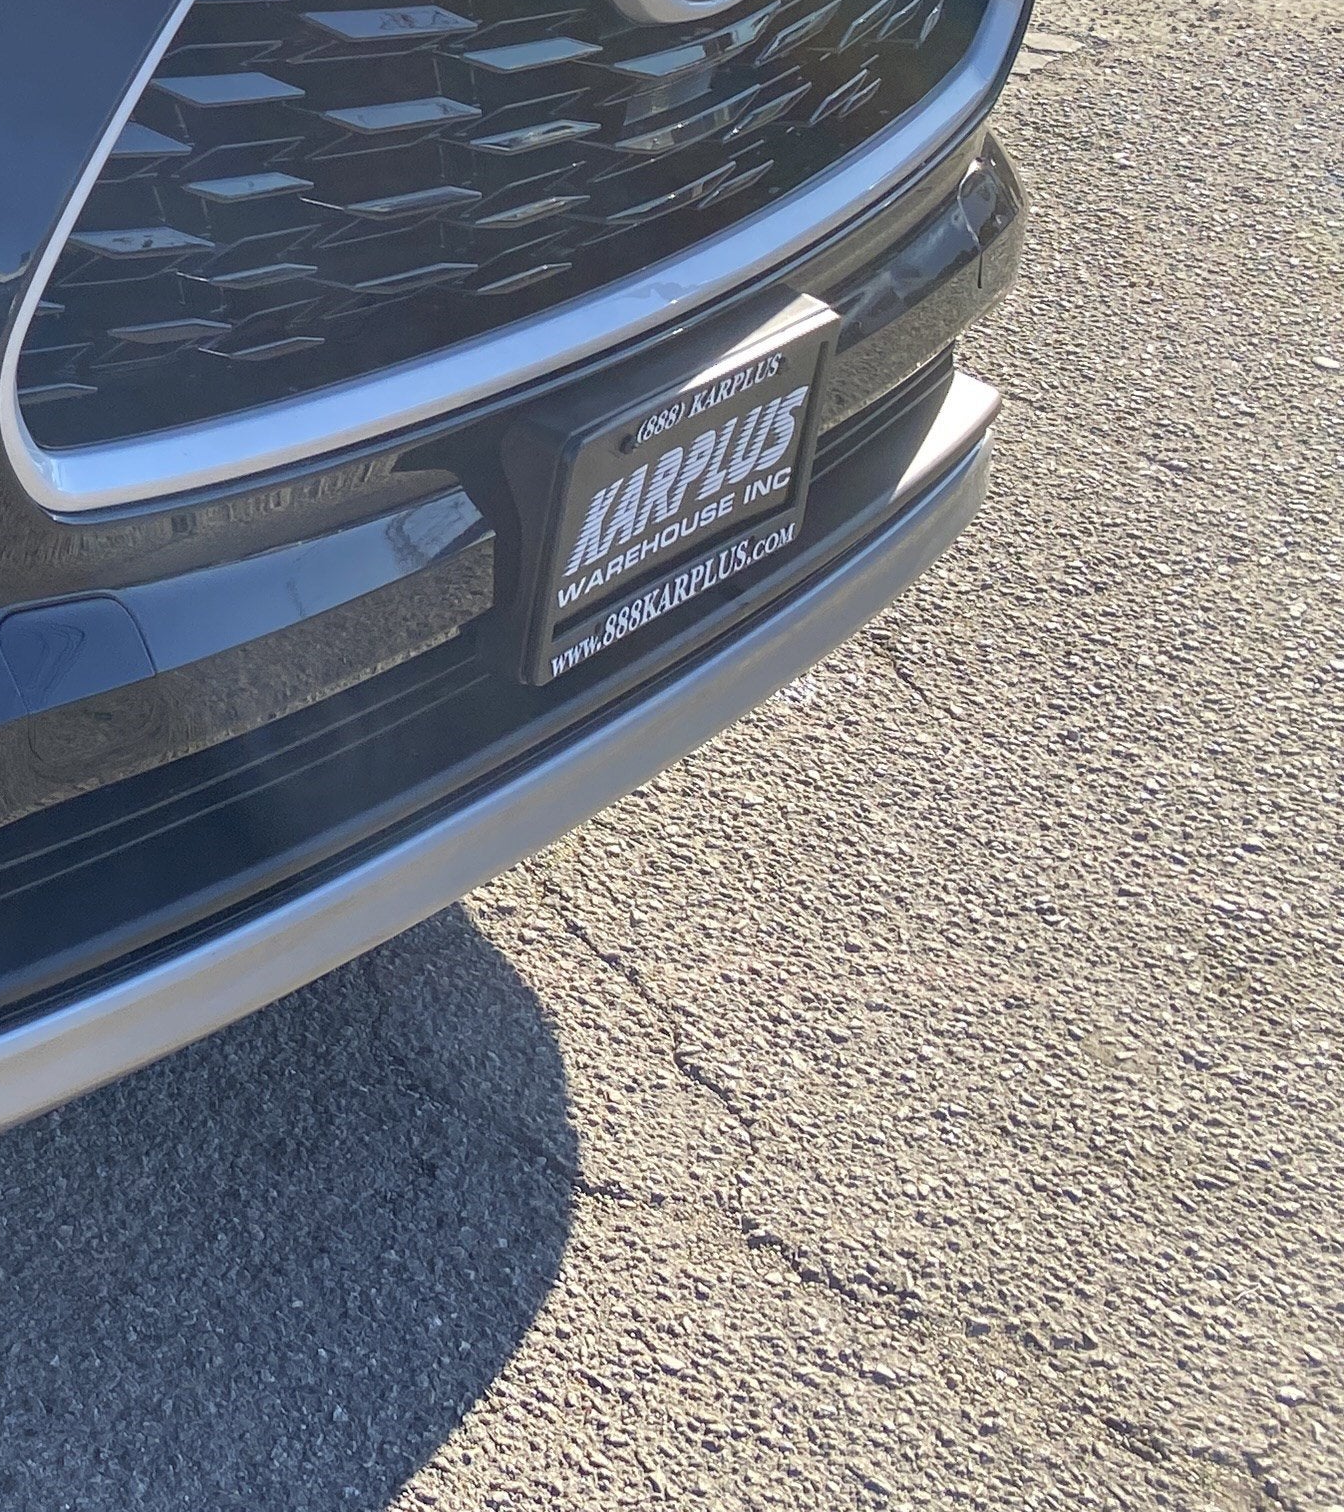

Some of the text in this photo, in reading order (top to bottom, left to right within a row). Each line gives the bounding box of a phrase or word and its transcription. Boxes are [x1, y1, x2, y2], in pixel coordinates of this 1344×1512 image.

[635, 352, 783, 445] (888) KARPLUS
[556, 465, 793, 609] WAREHOUSE INC
[563, 385, 810, 578] KARPLUS
